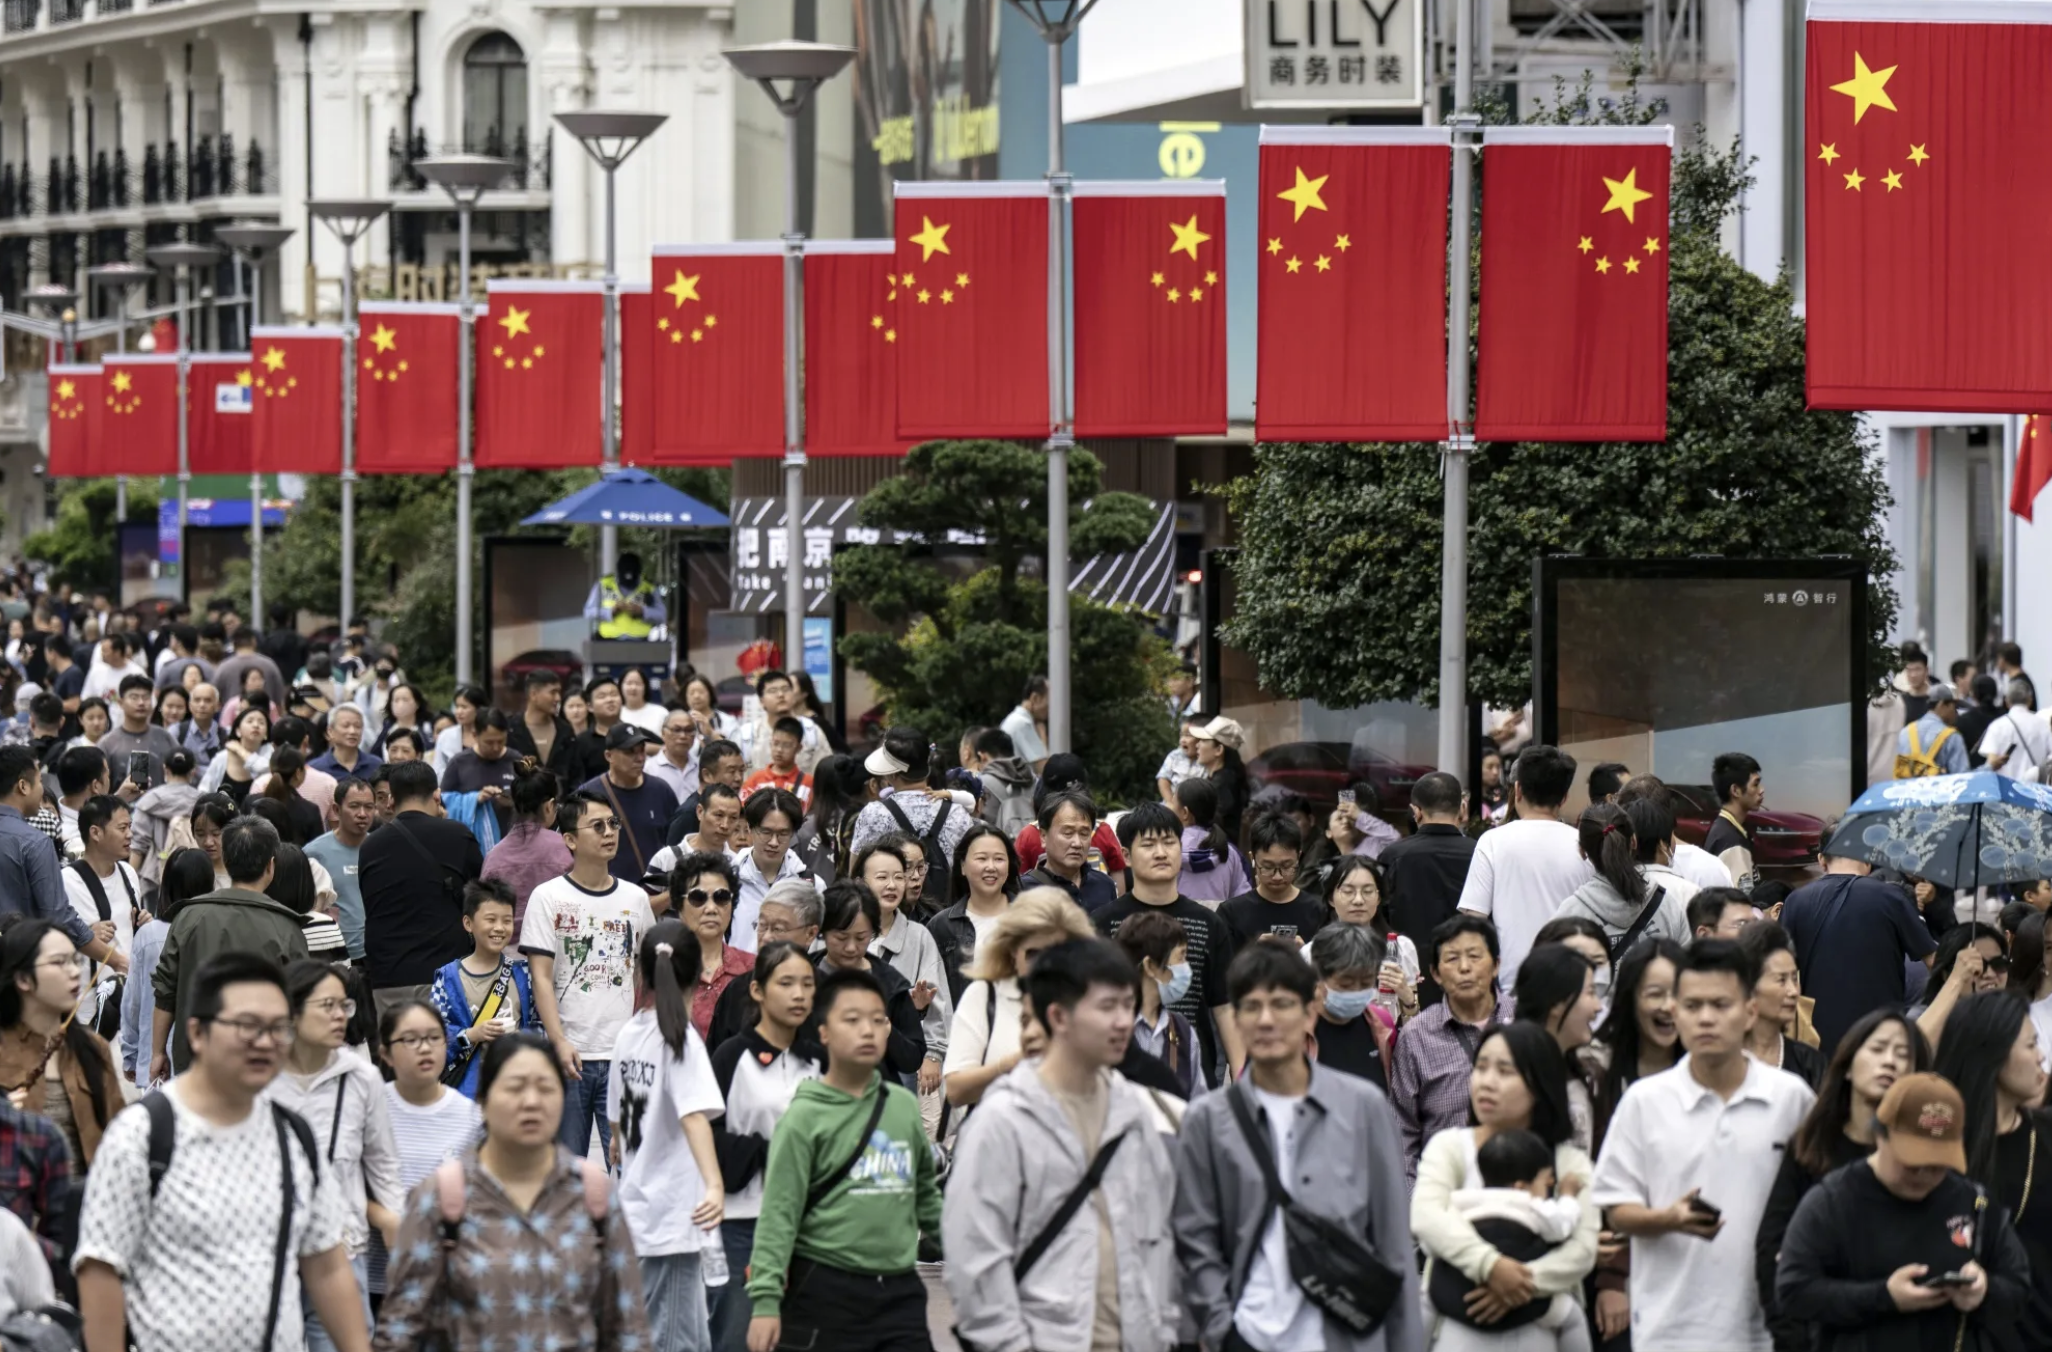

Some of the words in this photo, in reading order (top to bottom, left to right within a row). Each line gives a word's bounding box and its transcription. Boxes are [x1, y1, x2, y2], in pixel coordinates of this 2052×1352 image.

[1269, 0, 1400, 47] LILY
[1269, 55, 1402, 86] 商务时装
[618, 511, 674, 523] POLICE
[1813, 592, 1837, 604] 智行
